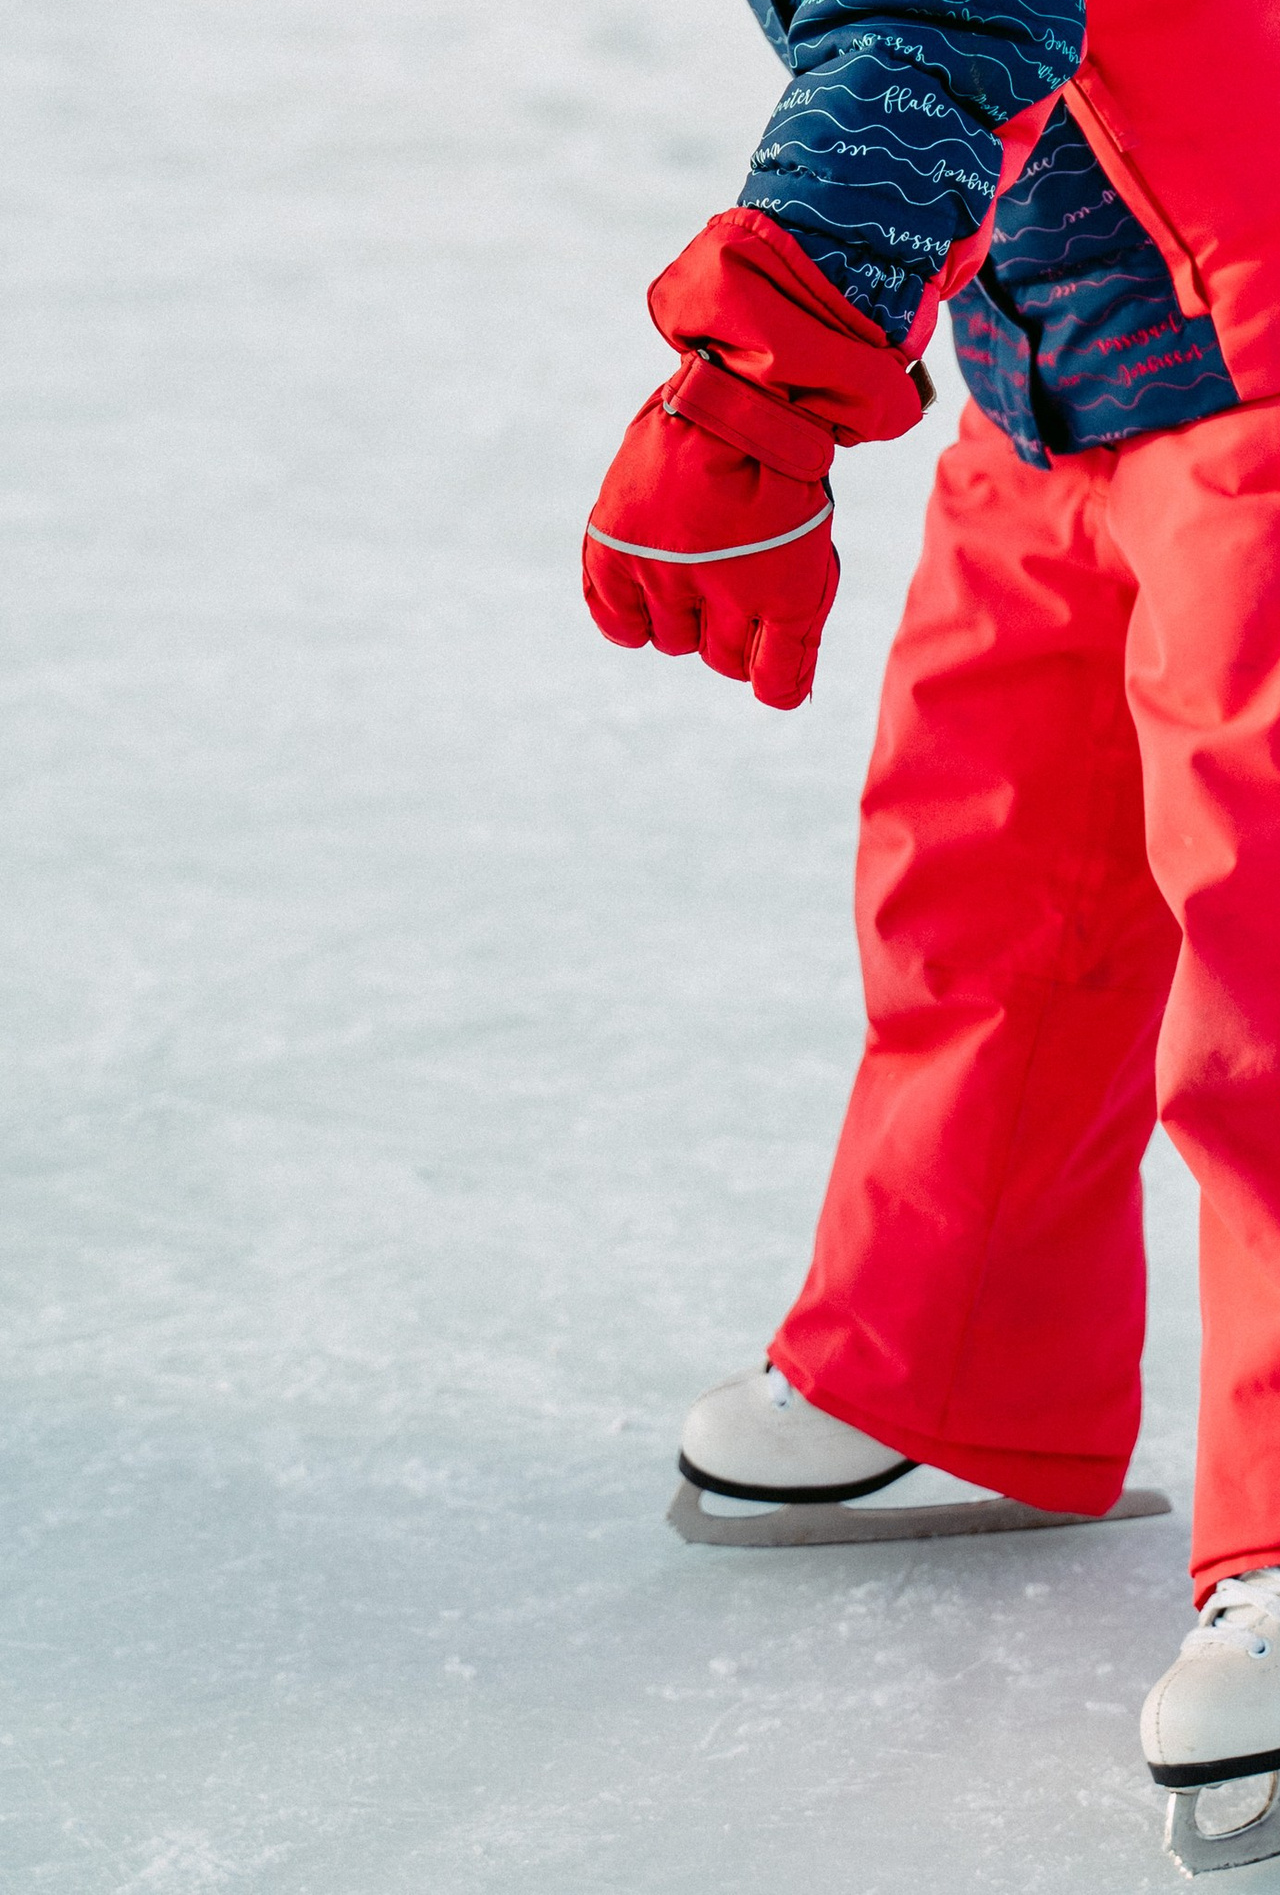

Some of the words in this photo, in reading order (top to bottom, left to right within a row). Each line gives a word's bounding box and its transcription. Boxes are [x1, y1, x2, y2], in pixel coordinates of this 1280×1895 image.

[884, 85, 949, 118] flake
[836, 140, 867, 156] ice
[1026, 157, 1052, 177] ice
